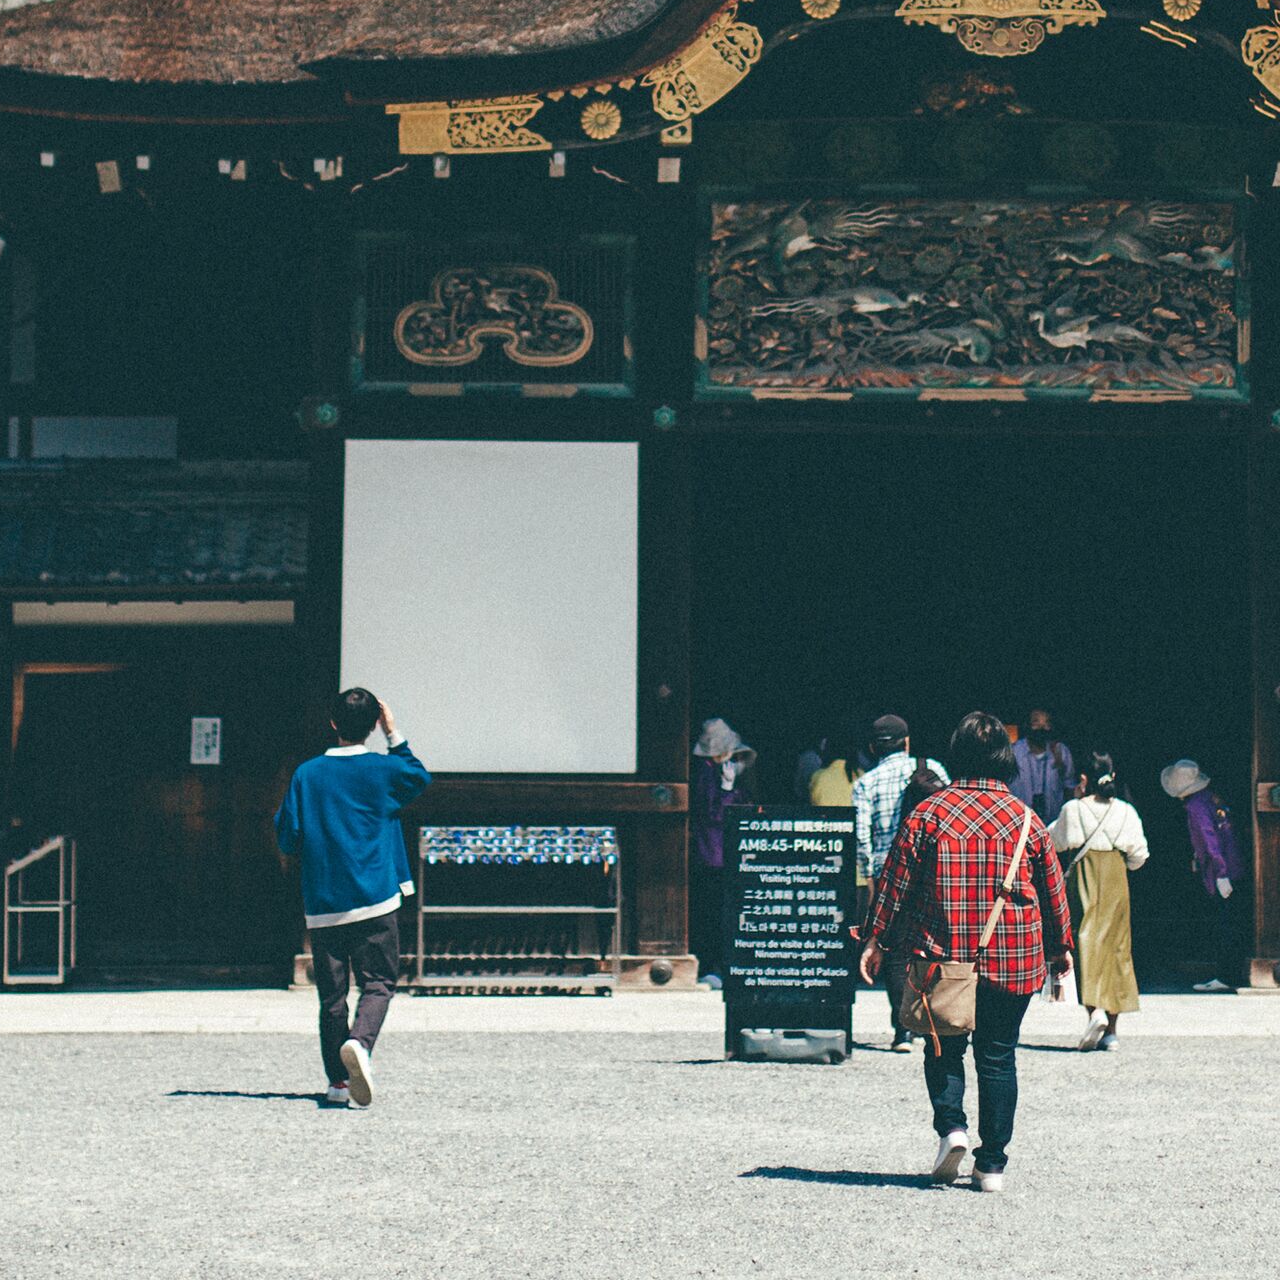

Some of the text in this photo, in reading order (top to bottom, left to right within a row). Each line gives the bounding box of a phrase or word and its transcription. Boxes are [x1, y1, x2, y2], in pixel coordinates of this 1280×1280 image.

[738, 839, 844, 852] AM8:45-PM4:10
[739, 863, 841, 874] Ninomaru-goten Palace
[760, 873, 820, 884] Visiting Hours
[735, 939, 844, 949] Heures de visite du Palais
[754, 949, 827, 960] Ninomaru-goten
[730, 966, 849, 976] Horario de visita del Palacio
[745, 977, 755, 986] de
